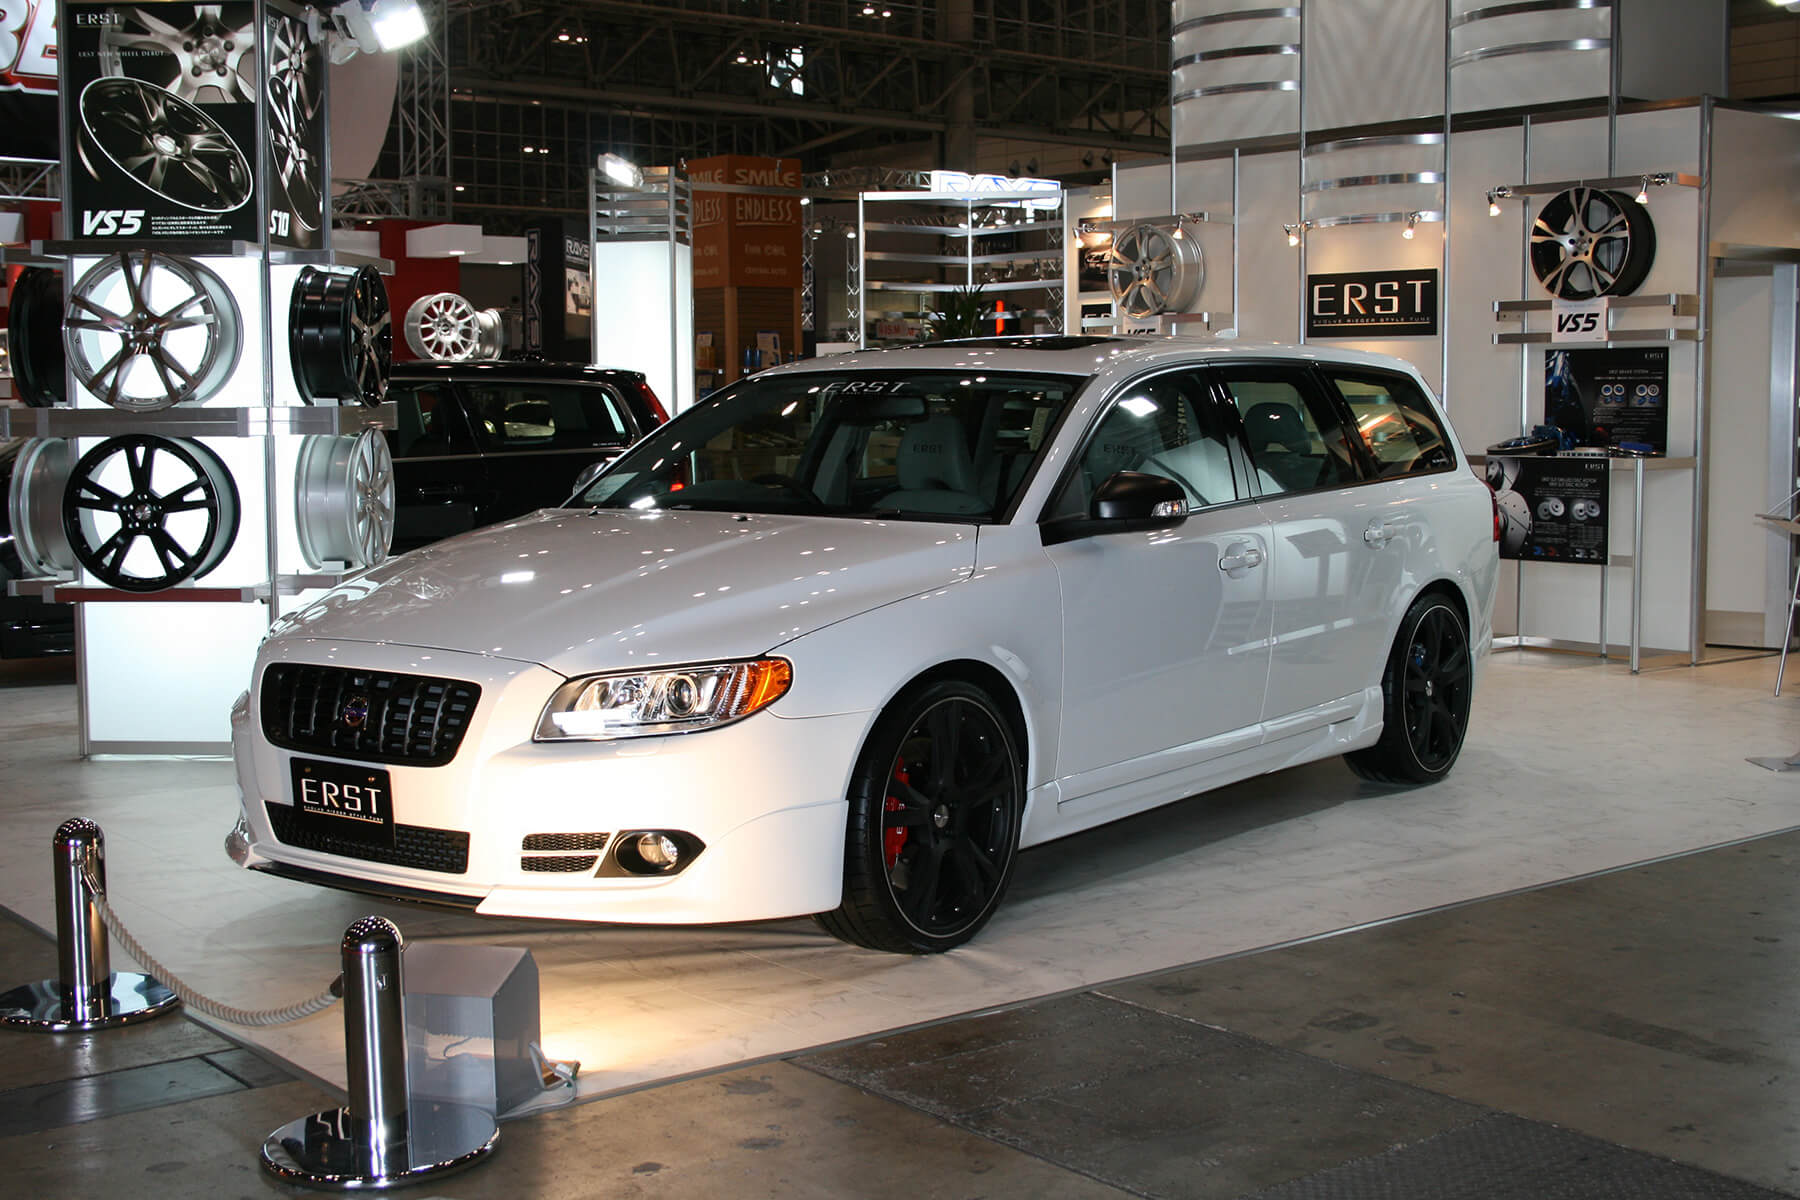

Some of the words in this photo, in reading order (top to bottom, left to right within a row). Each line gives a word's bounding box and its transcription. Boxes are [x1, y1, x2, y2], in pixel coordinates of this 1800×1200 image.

[76, 13, 120, 25] ERST
[692, 169, 724, 185] MILE
[735, 169, 797, 187] SMILE
[83, 209, 145, 236] VS5
[269, 209, 290, 237] S10
[565, 239, 590, 258] RAYS
[1313, 280, 1431, 316] ERST
[1557, 312, 1600, 333] VS5
[822, 381, 911, 393] ERST
[301, 778, 382, 814] ERST
